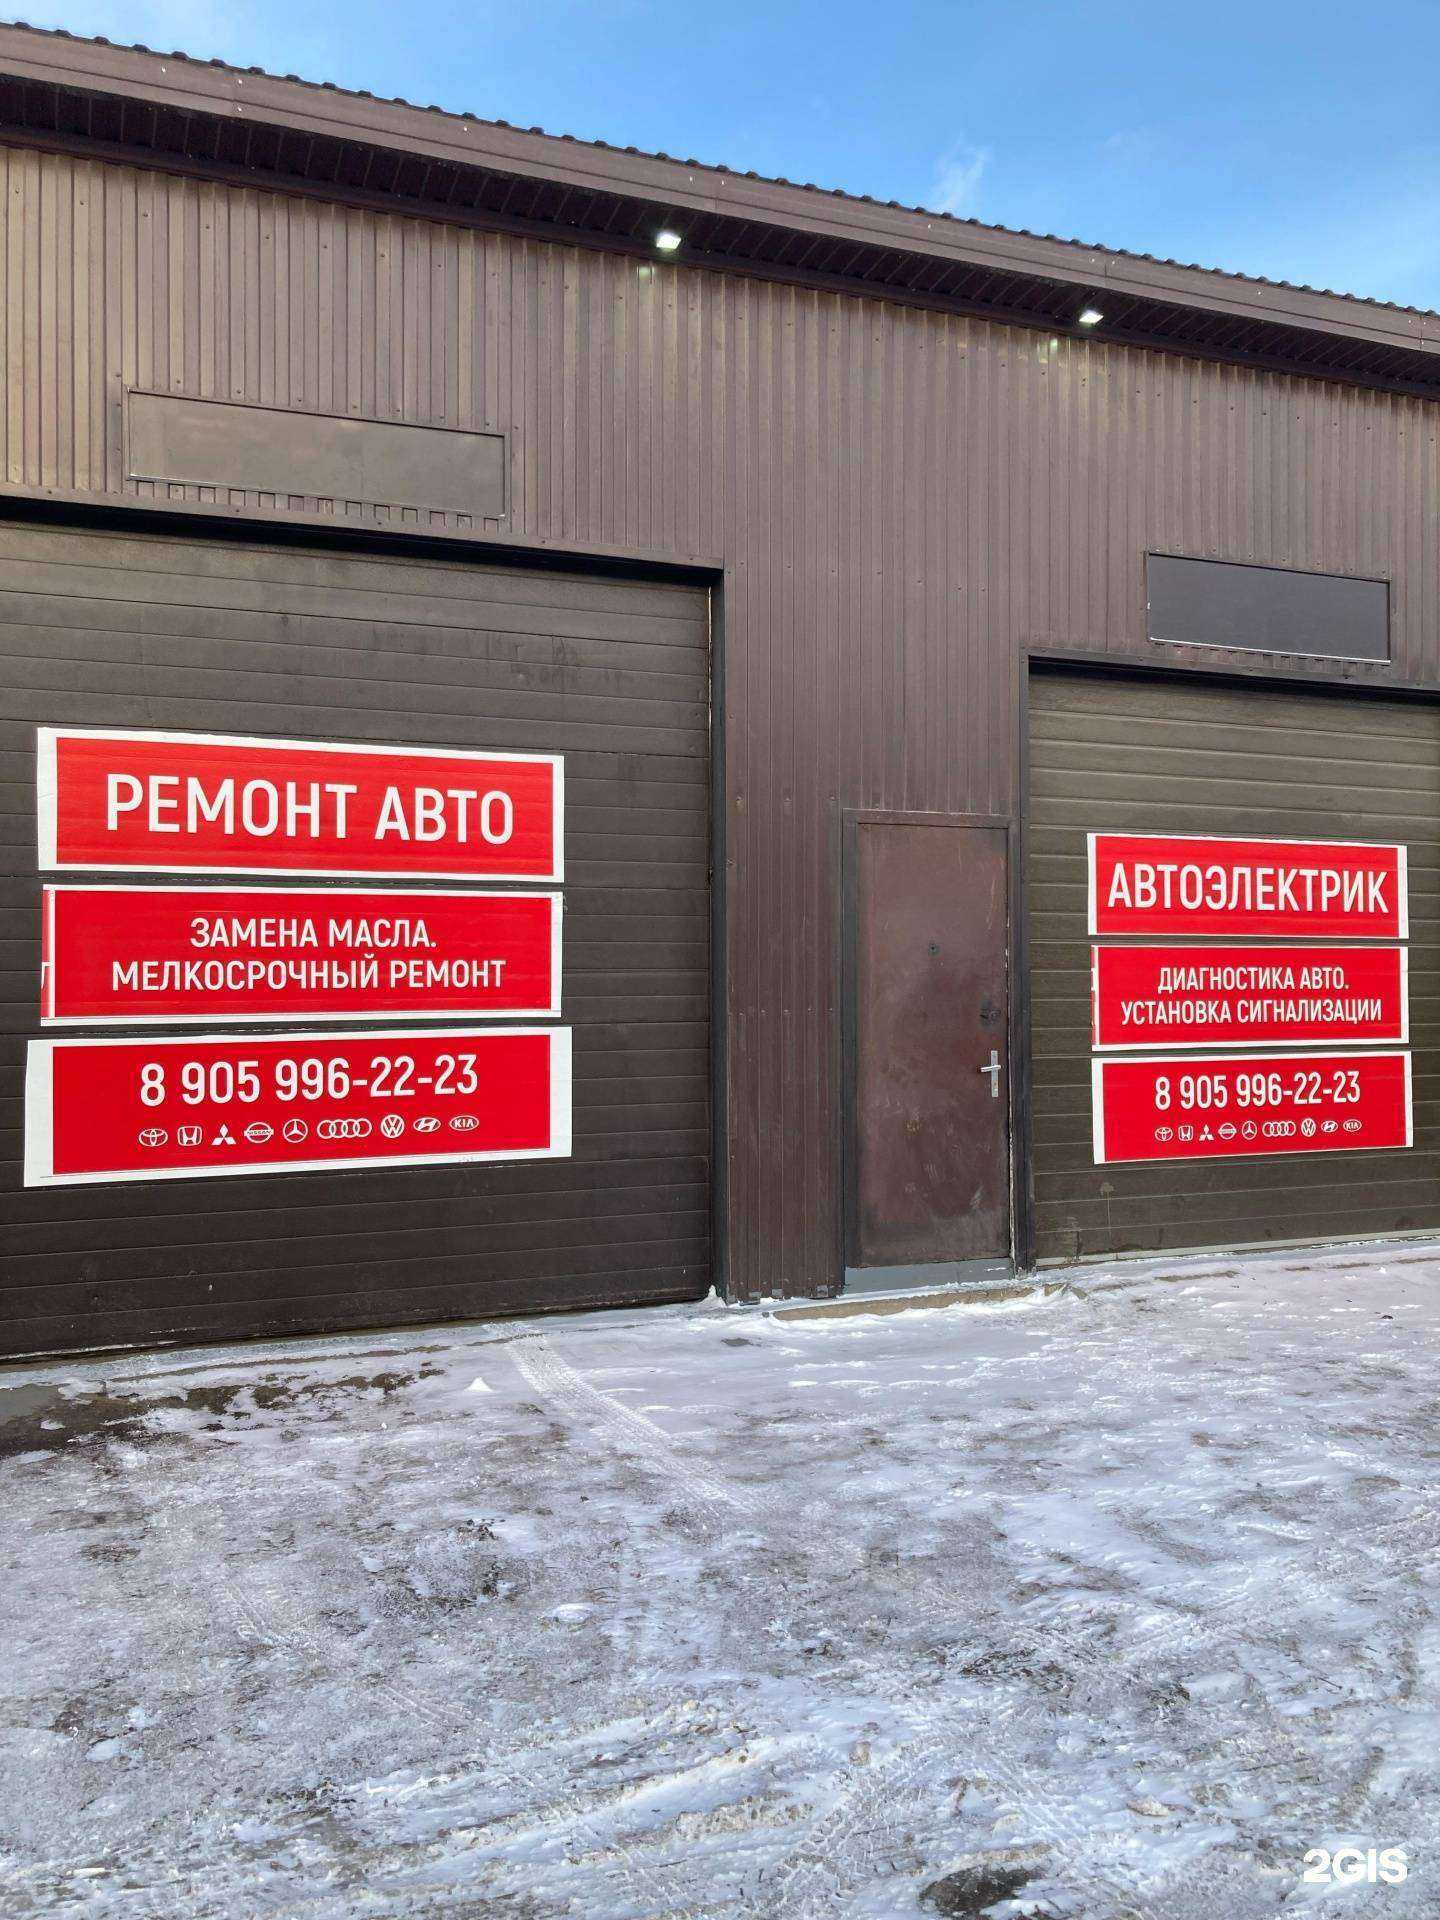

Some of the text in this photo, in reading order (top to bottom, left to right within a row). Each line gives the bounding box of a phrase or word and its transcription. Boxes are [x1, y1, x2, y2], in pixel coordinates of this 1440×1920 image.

[107, 773, 515, 845] РЕМОНТ АВТО
[1107, 862, 1389, 914] АВТОЭЛЕКТРИК
[190, 917, 438, 949] ЗАМЕНА МАСЛА.
[112, 953, 507, 991] МЕЛКОСРОЧНЫЙ РЕМОНТ
[1157, 966, 1350, 994] ДИАГНОСТИКА АВТО.
[1120, 998, 1382, 1026] УСТАНОВКА СИГНАЛИЗАЦИИ
[140, 1054, 478, 1107] 8 905 996-22-23
[1155, 1070, 1361, 1111] 8 905 996-22-23
